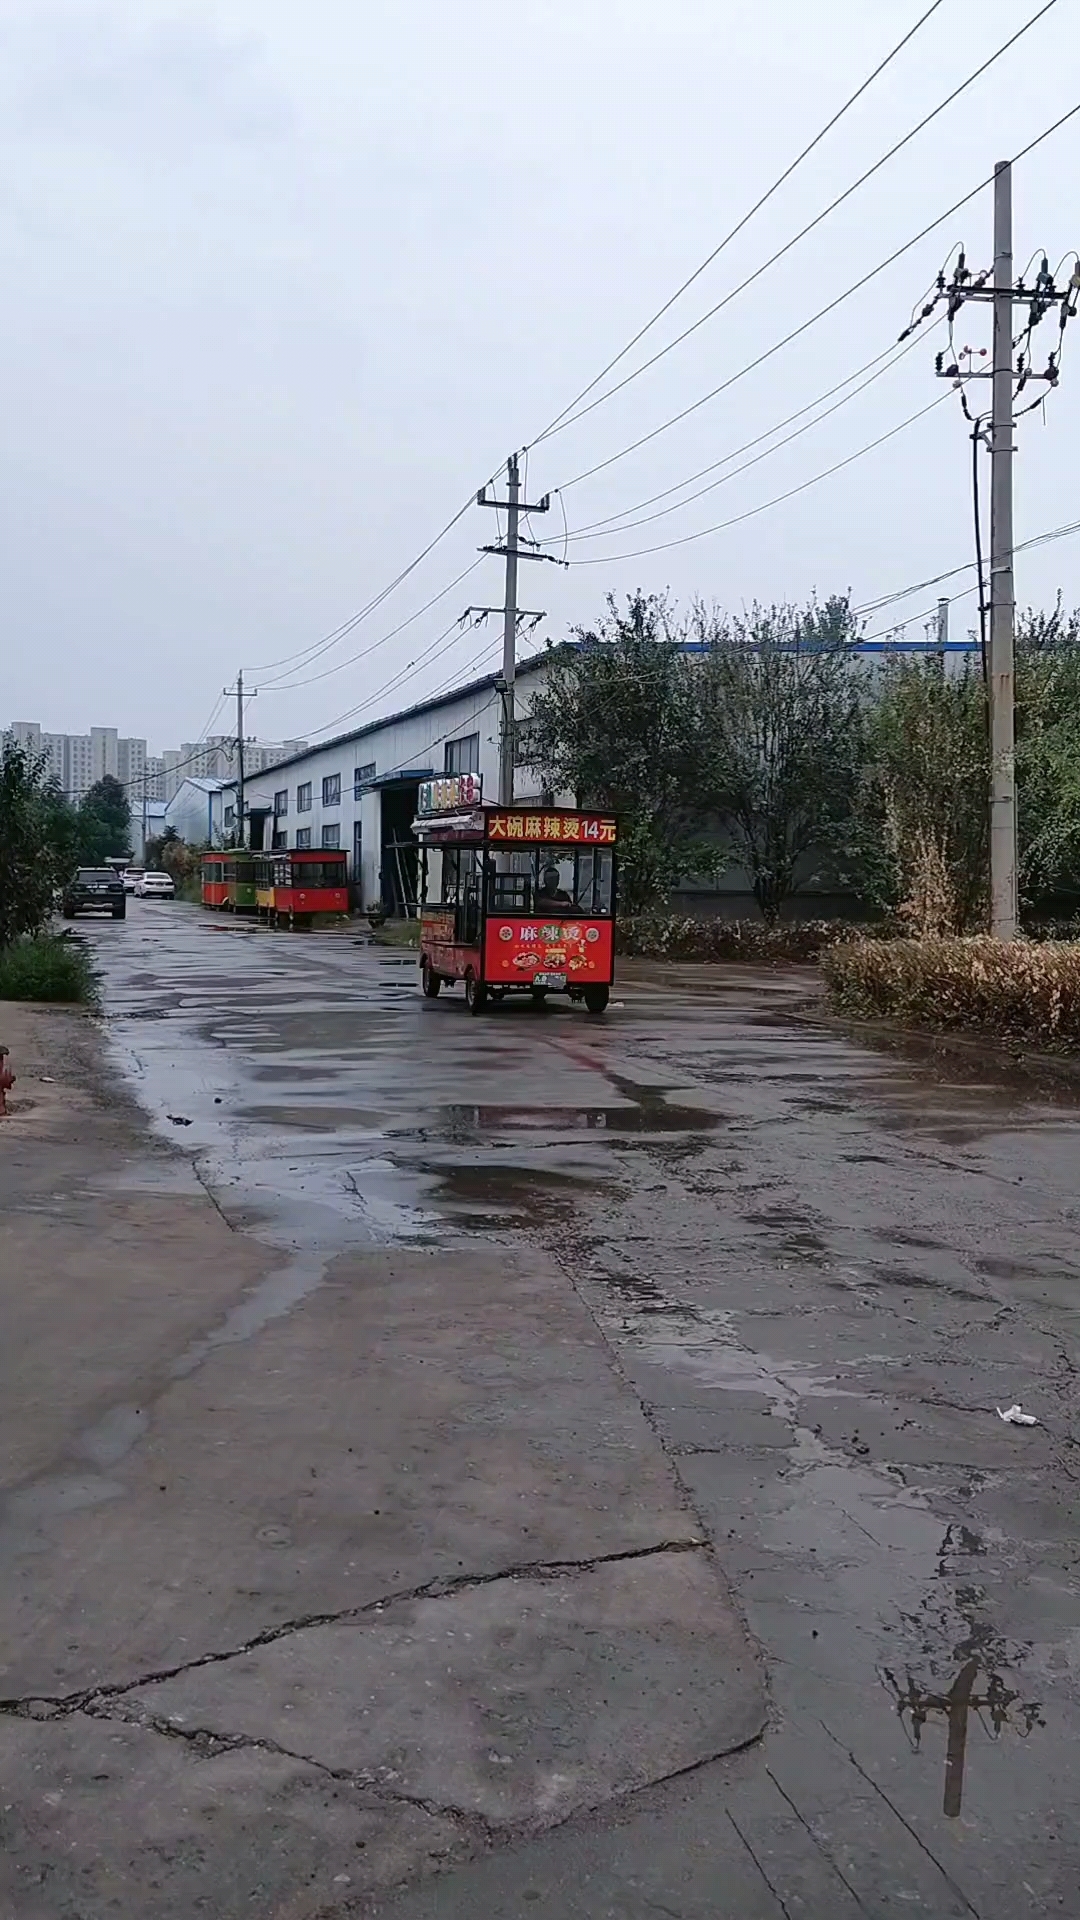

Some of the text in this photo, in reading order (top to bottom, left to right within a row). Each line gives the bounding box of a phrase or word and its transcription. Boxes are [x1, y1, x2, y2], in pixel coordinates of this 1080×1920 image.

[489, 815, 617, 841] 大碗麻辣烫14元
